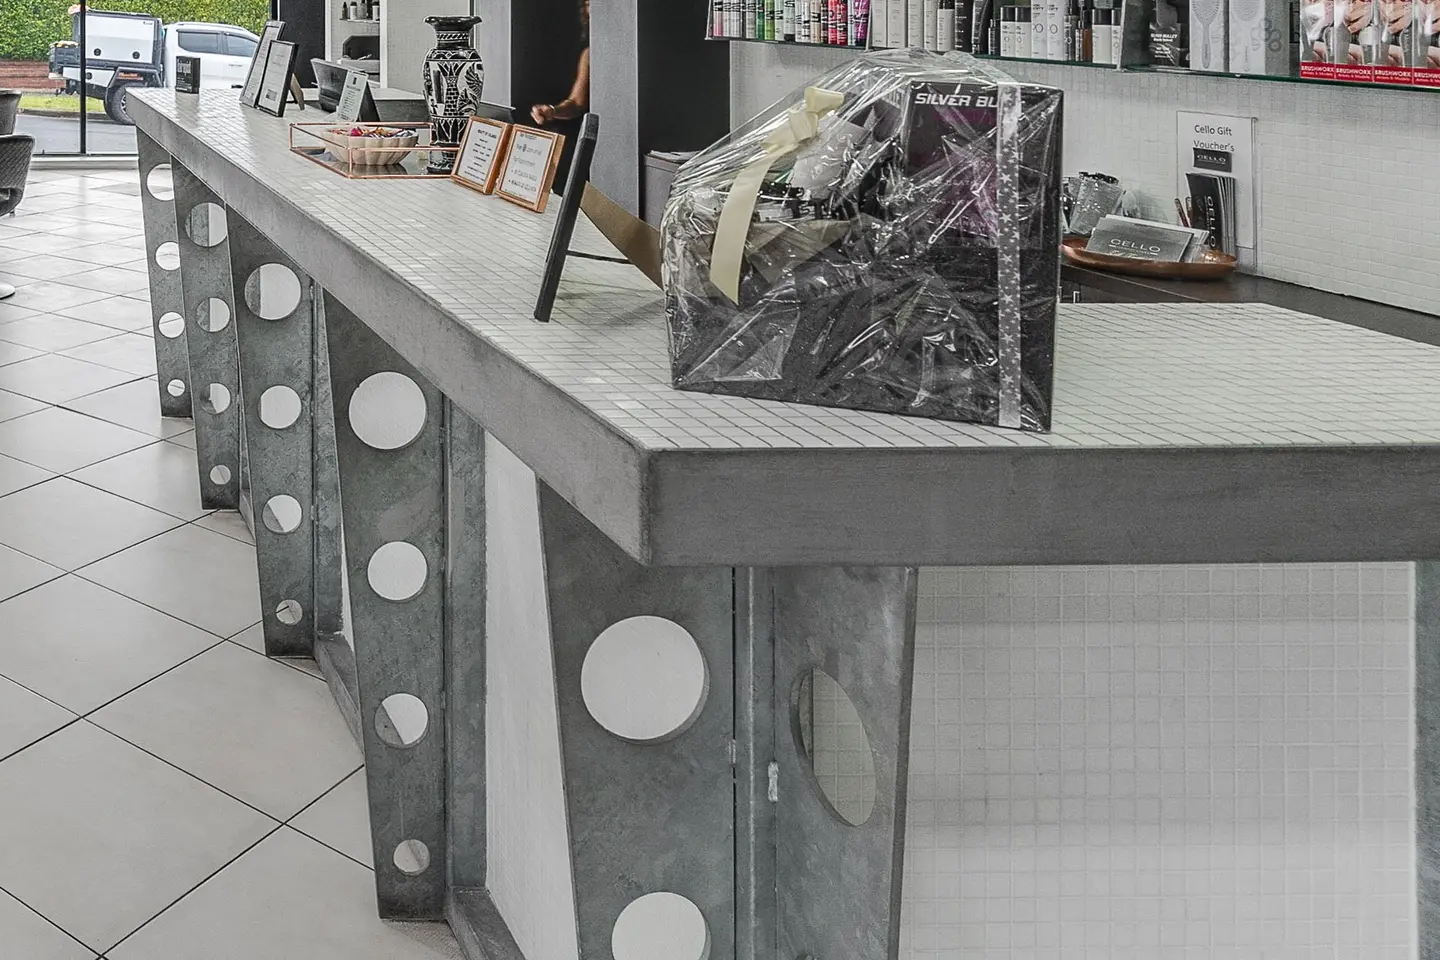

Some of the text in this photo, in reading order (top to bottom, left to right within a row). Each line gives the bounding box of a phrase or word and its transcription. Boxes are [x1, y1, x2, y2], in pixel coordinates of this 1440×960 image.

[914, 93, 972, 107] SILVER
[1194, 124, 1233, 137] Cello Gift
[1193, 140, 1235, 152] Voucher's
[1207, 195, 1217, 248] CELLO
[1110, 238, 1161, 252] CELLO
